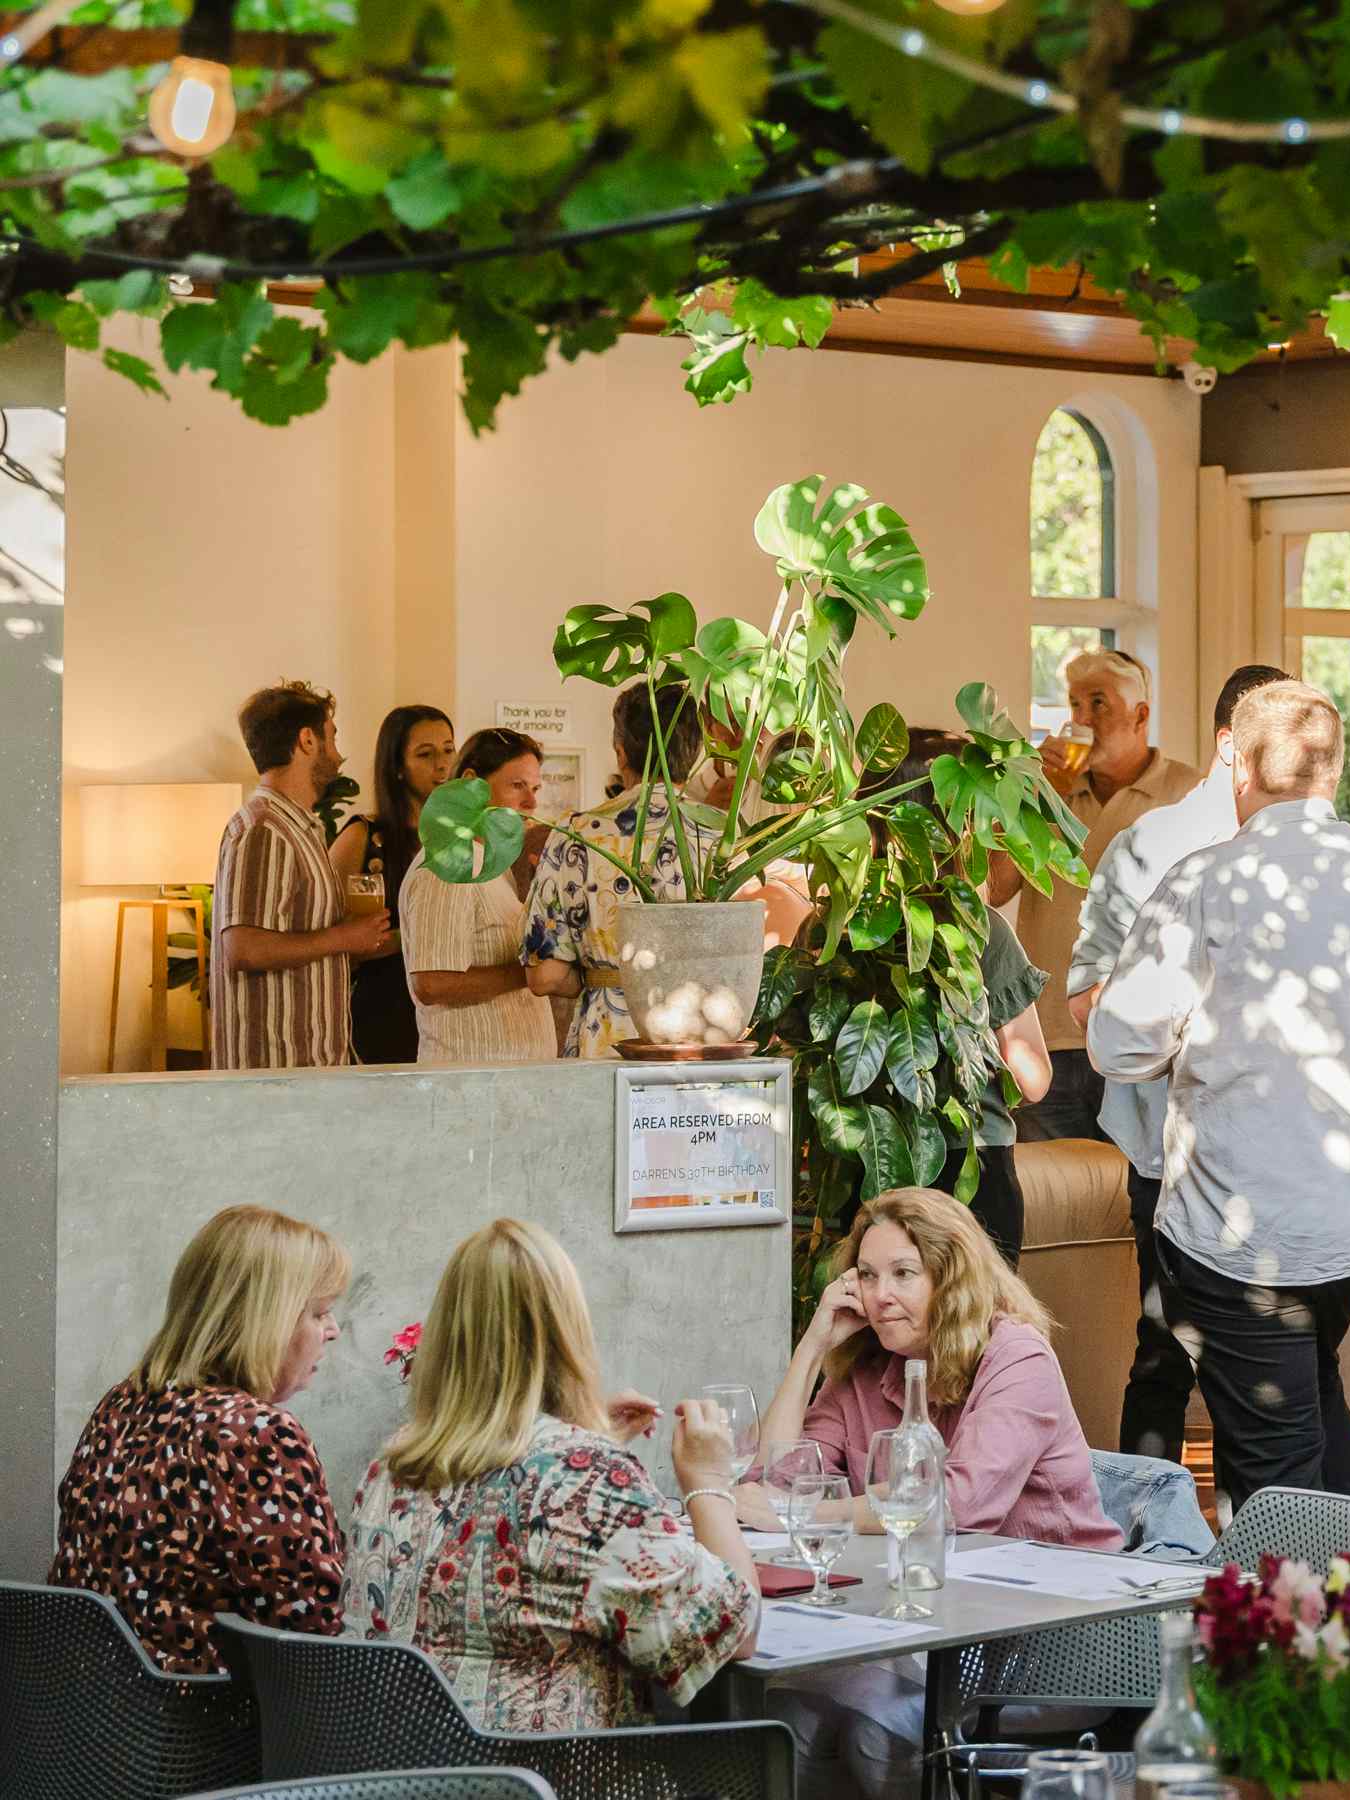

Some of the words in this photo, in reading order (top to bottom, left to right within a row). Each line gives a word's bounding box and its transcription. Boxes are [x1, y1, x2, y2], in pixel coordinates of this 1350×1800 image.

[503, 706, 529, 717] Thank
[534, 708, 552, 719] you
[554, 707, 567, 717] for
[505, 720, 521, 730] not
[523, 721, 564, 733] smoking
[632, 1116, 667, 1130] AREA
[669, 1114, 734, 1128] RESERVED
[737, 1113, 772, 1126] FROM
[690, 1131, 717, 1146] 4PM
[632, 1167, 686, 1182] DARREN'S
[718, 1163, 770, 1178] BIRTHDAY
